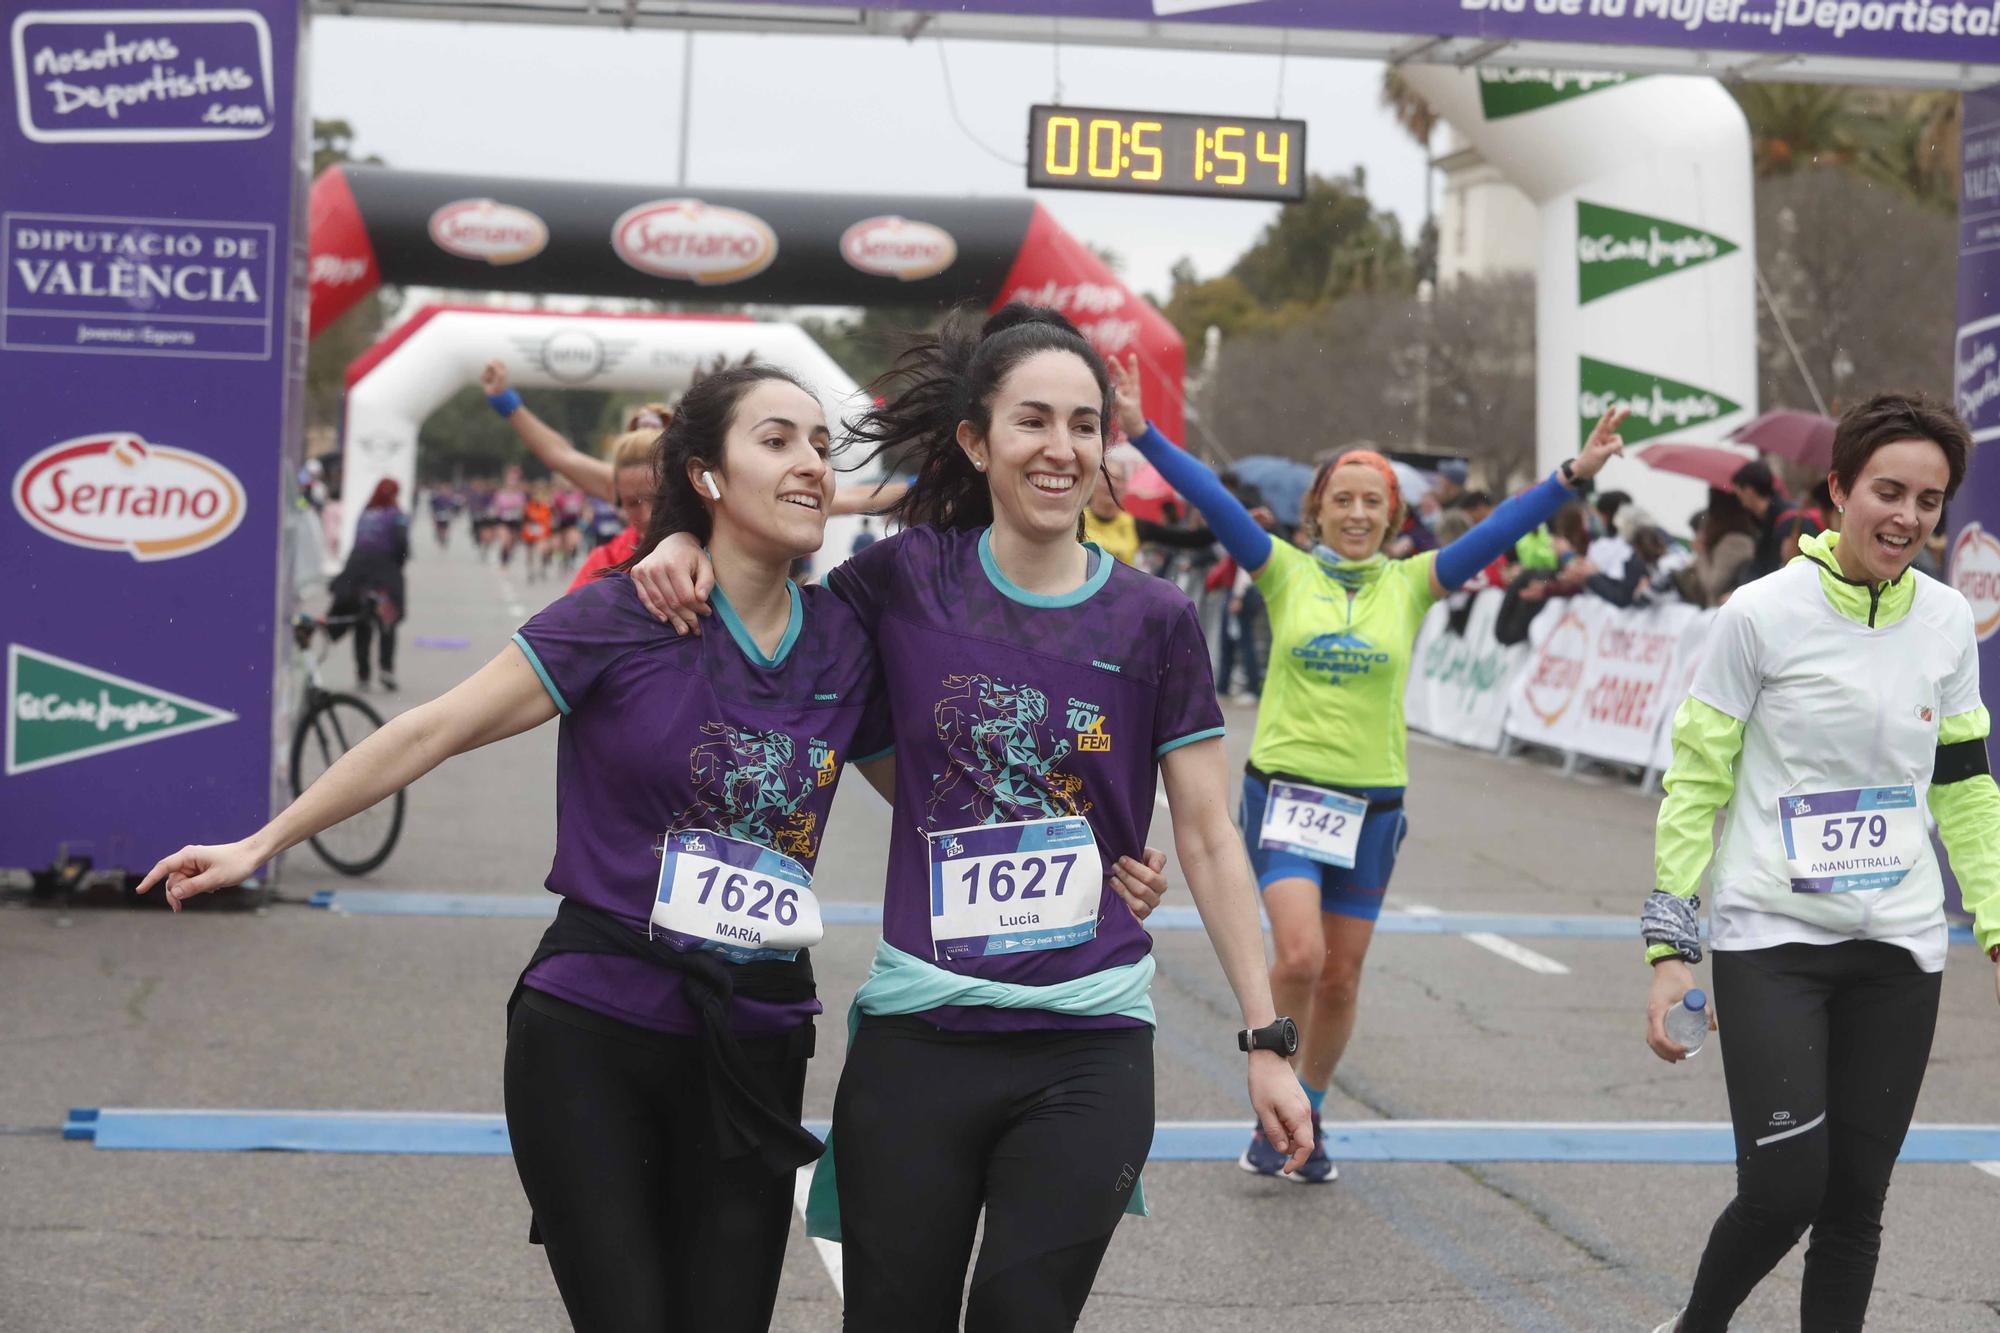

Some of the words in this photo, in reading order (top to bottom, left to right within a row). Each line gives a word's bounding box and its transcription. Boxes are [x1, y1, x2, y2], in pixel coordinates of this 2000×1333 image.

[46, 58, 253, 119] Deportistas
[214, 236, 258, 260] DE
[637, 223, 759, 258] Serrano
[44, 467, 219, 520] Serrano
[1092, 659, 1121, 673] RUNNEK
[1065, 708, 1106, 734] 10K
[1079, 735, 1109, 751] FEM
[1286, 805, 1347, 838] 1342
[1821, 814, 1887, 852] 579
[1811, 855, 1901, 873] ANANUTTRALIA
[961, 853, 1077, 905] 1627
[696, 865, 799, 926] 1626
[716, 922, 762, 944] MARÍA
[999, 911, 1040, 927] Lucía
